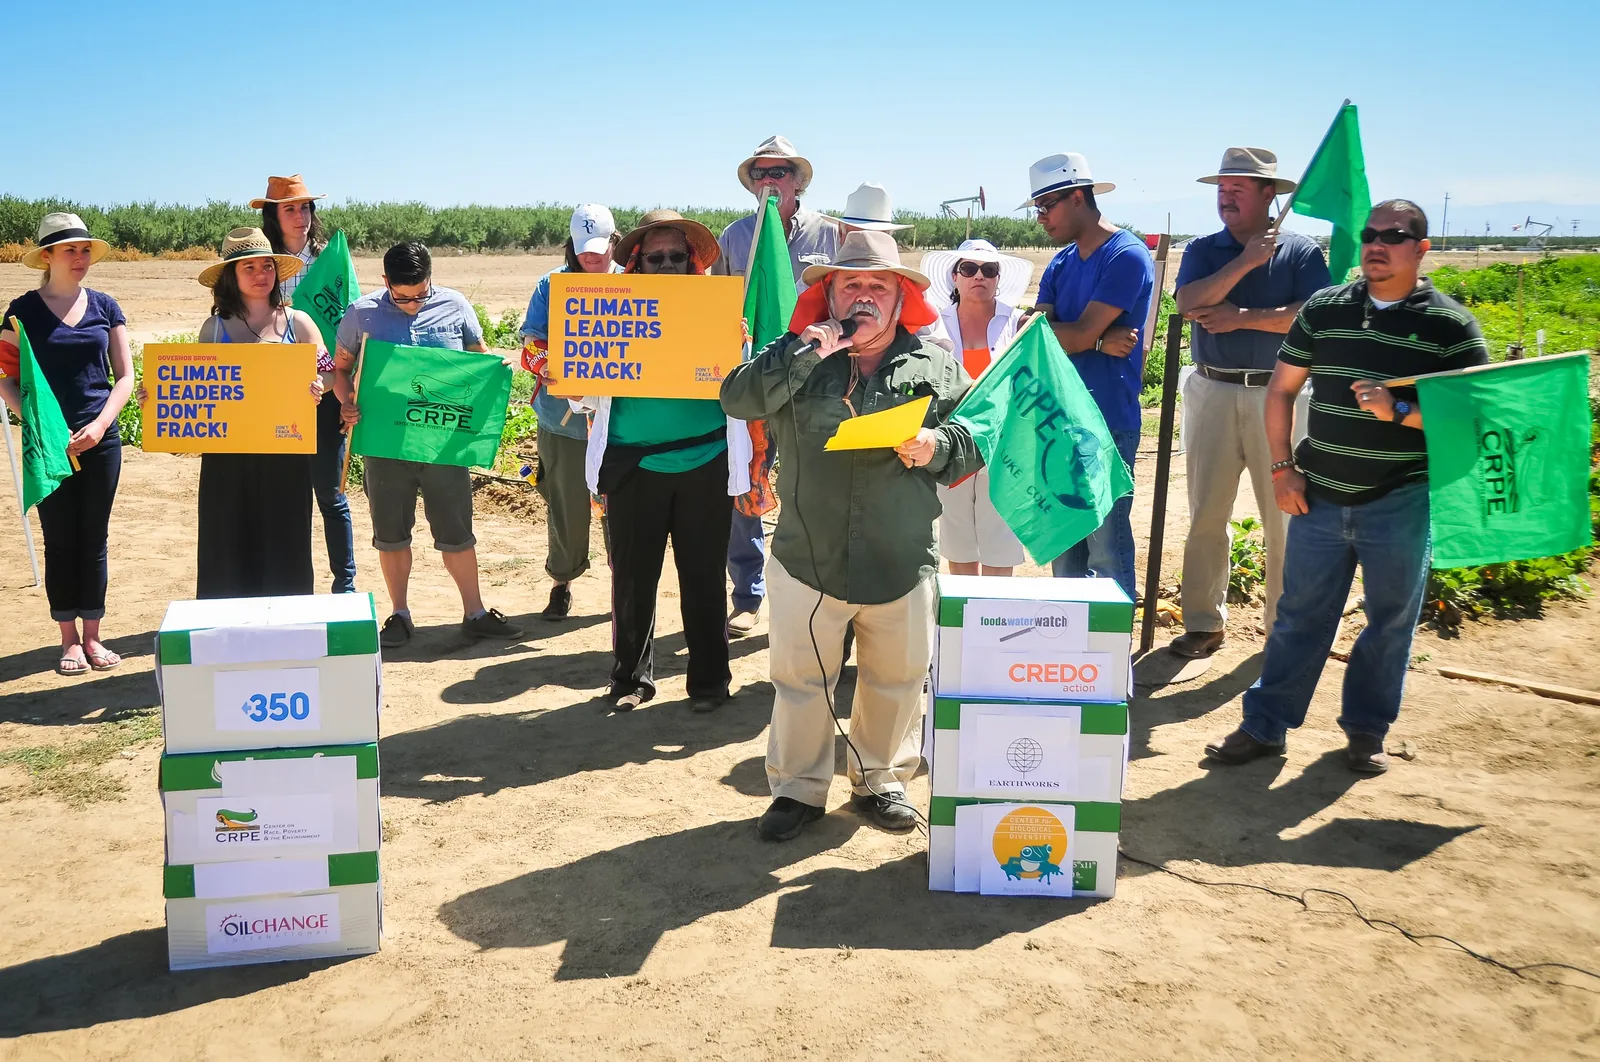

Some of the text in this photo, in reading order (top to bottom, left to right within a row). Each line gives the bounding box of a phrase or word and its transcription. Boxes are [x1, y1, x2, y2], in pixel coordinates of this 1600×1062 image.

[565, 297, 659, 317] CLIMATE
[564, 319, 662, 339] LEADERS
[564, 340, 630, 359] DON'T
[157, 365, 242, 381] CLIMATE
[563, 361, 642, 380] FRACK!
[157, 384, 245, 401] LEADERS
[156, 403, 216, 419] DON'T
[1012, 365, 1070, 442] CRPE
[406, 408, 472, 430] CRPE
[156, 422, 228, 438] FRACK!
[1482, 431, 1506, 515] CRPE
[1008, 663, 1098, 683] CREDO
[1063, 684, 1096, 693] action
[249, 691, 310, 722] 350
[988, 780, 1060, 788] EARTHWORKS
[215, 831, 260, 843] CRPE
[1009, 825, 1053, 833] BIOLOGICAL
